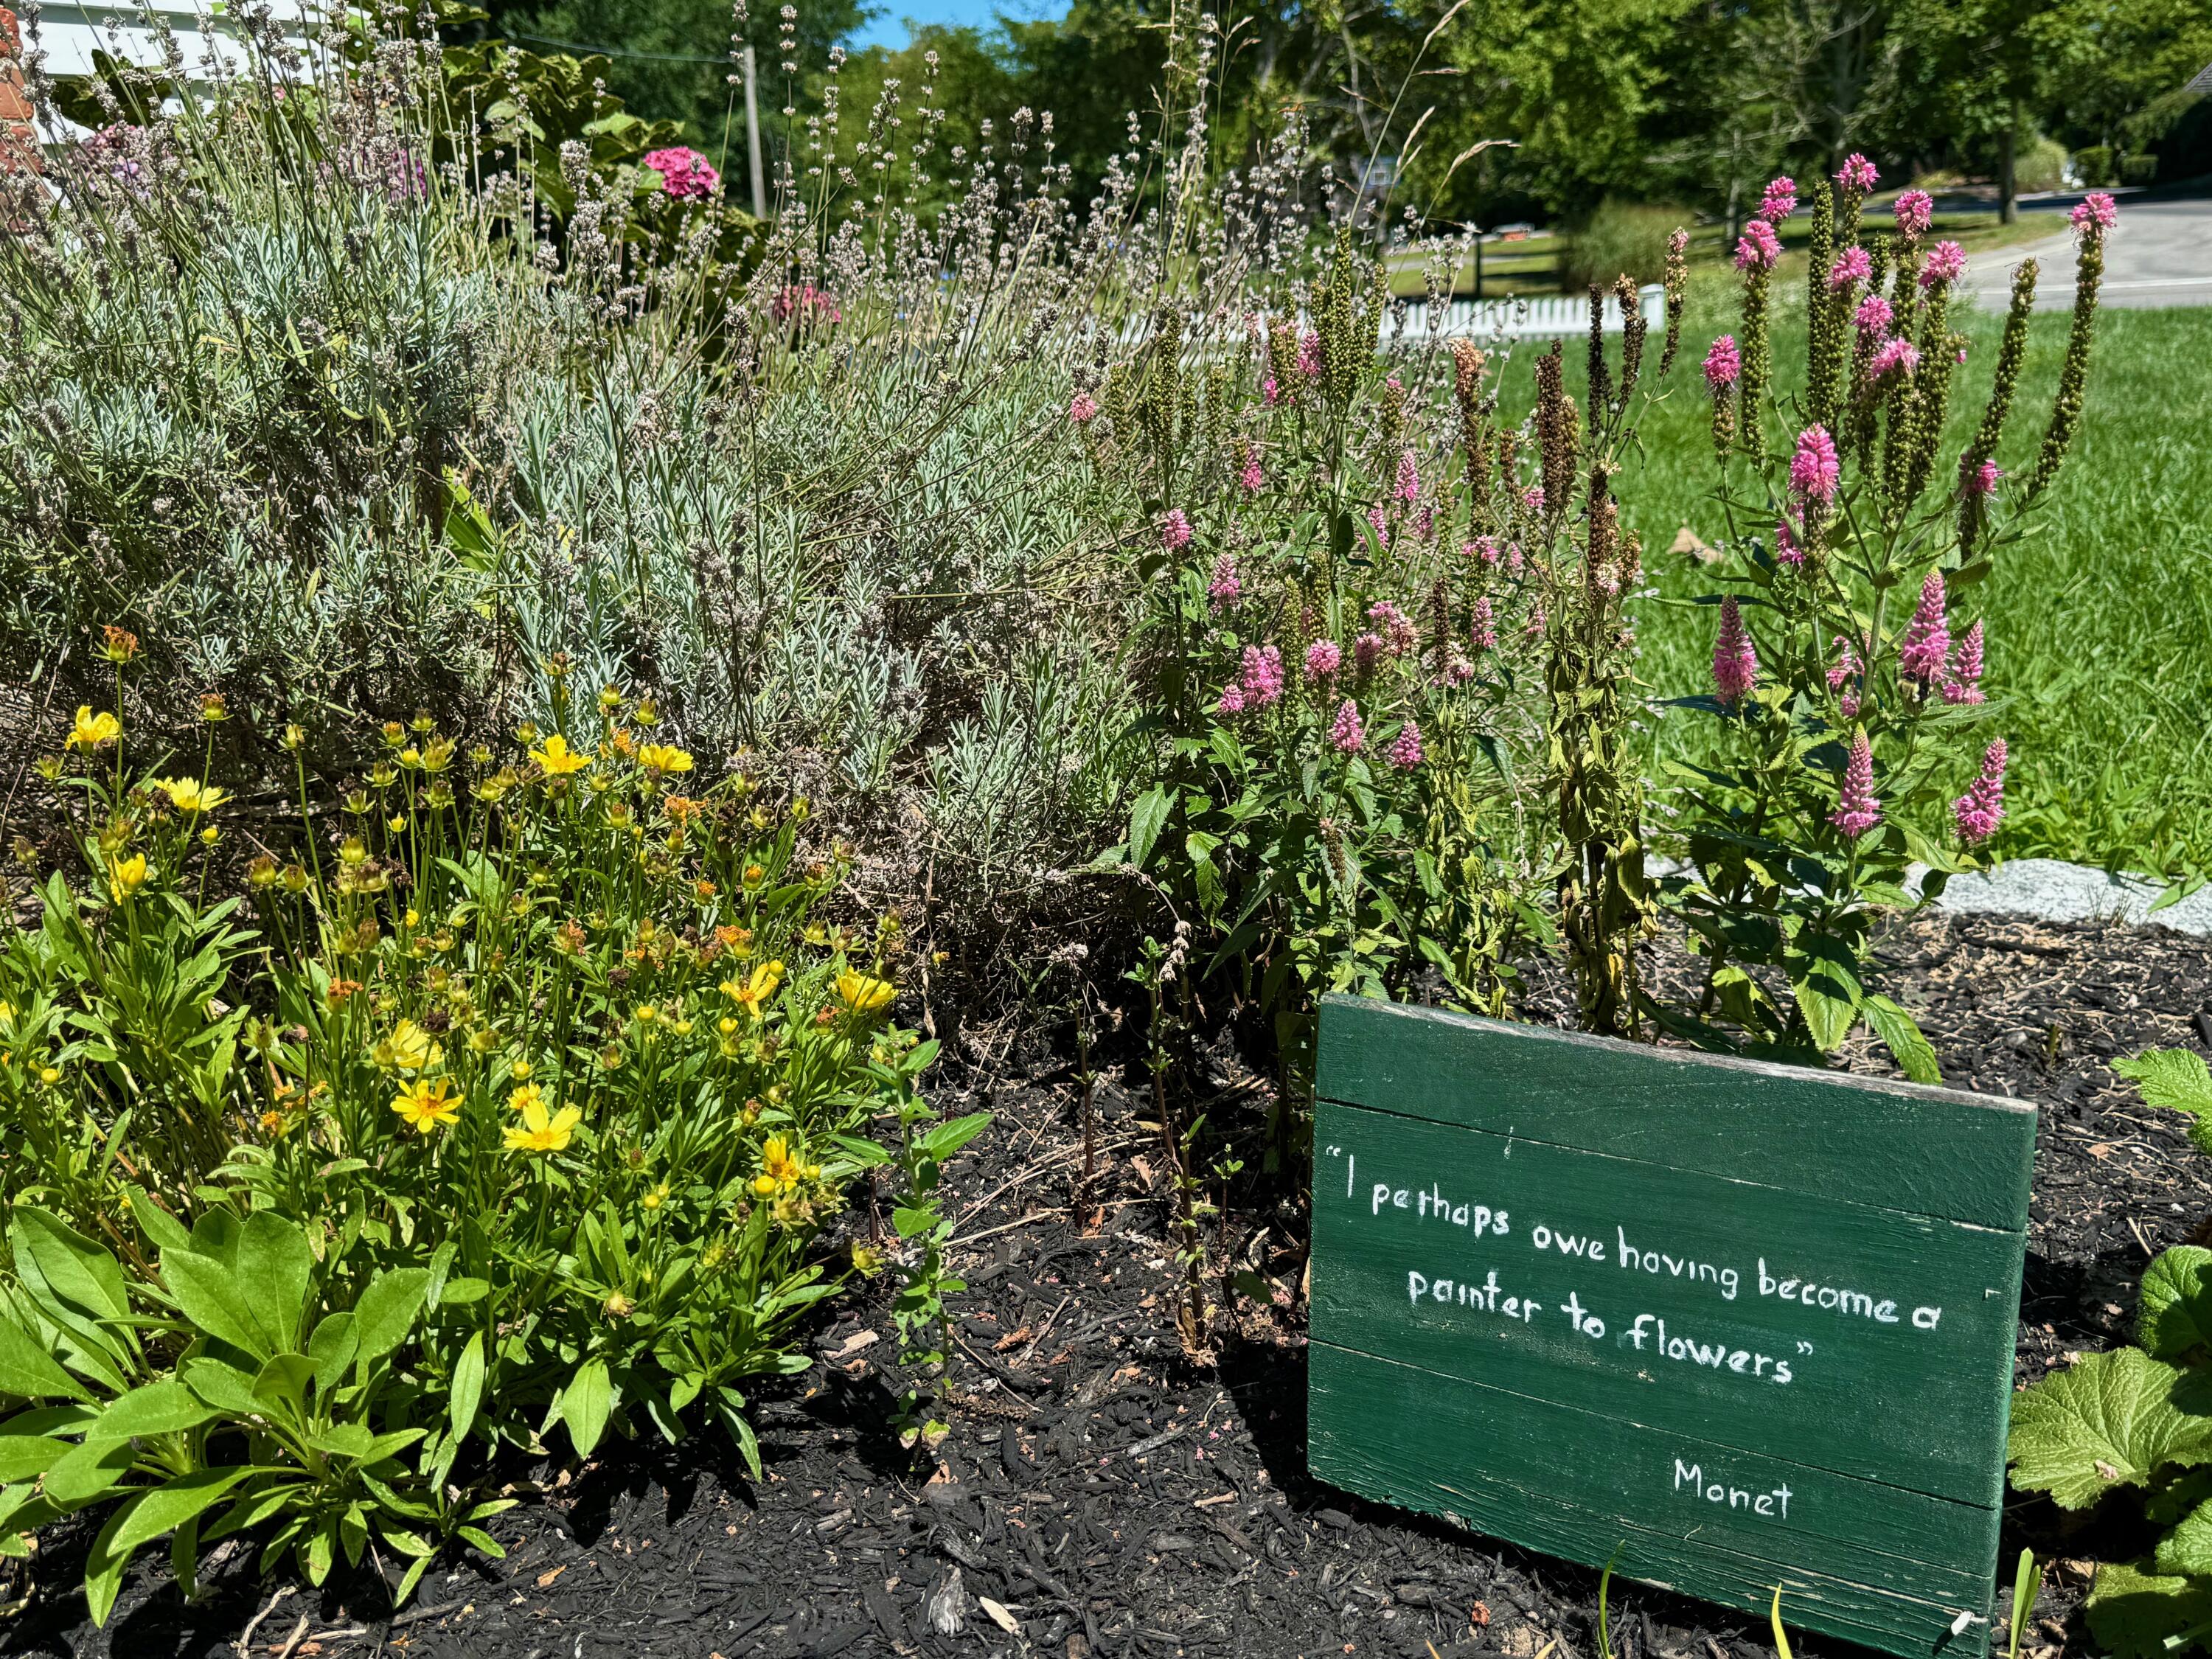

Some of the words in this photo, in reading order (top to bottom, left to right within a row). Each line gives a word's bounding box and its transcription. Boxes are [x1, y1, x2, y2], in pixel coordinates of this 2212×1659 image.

[1372, 1182, 1510, 1239] perhaps
[1532, 1225, 1607, 1261] owe
[1617, 1225, 1739, 1301] having
[1758, 1256, 1900, 1324] become
[1911, 1305, 1943, 1330] a
[1407, 1269, 1543, 1324] painter
[1559, 1290, 1607, 1340] to
[1674, 1458, 1794, 1520] Monet
